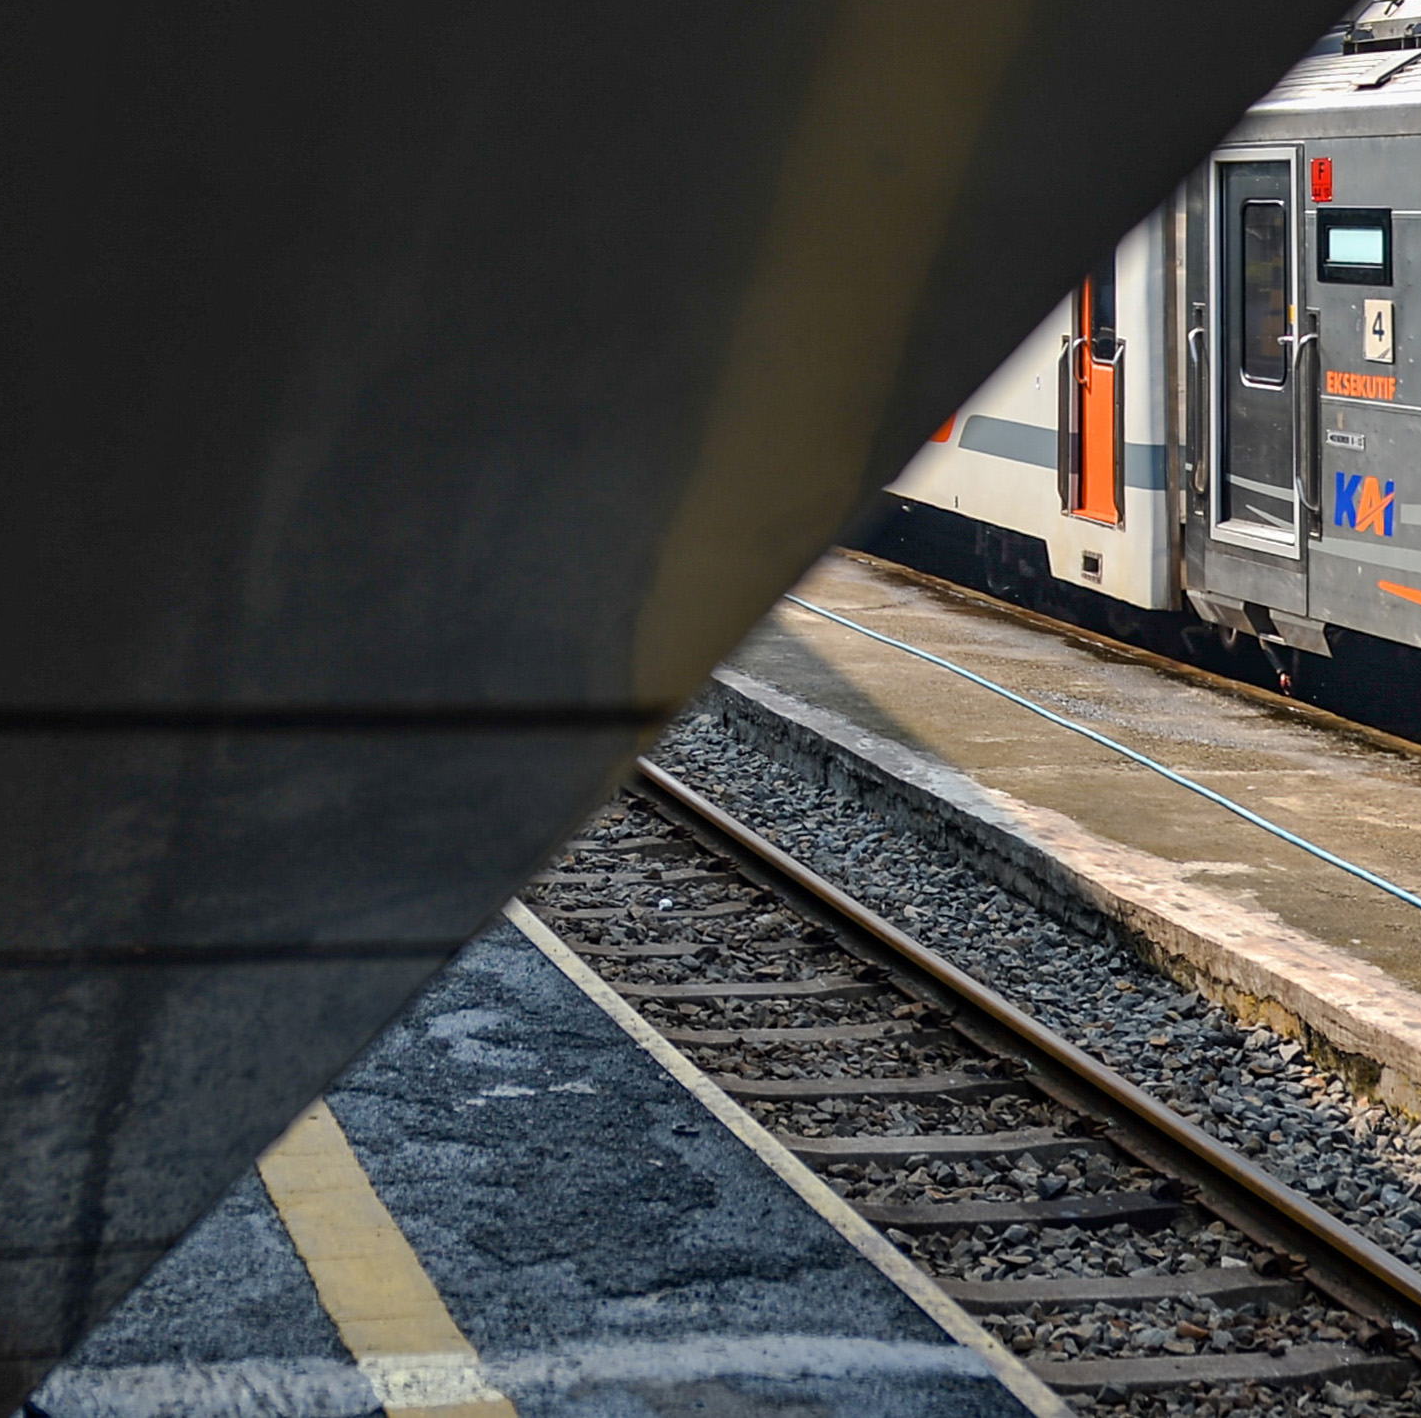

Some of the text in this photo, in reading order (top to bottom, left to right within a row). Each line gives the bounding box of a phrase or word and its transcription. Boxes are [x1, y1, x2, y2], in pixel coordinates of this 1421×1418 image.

[1372, 311, 1385, 343] 4
[1326, 371, 1397, 400] EKSEKUTIF
[1334, 472, 1395, 537] KAI
